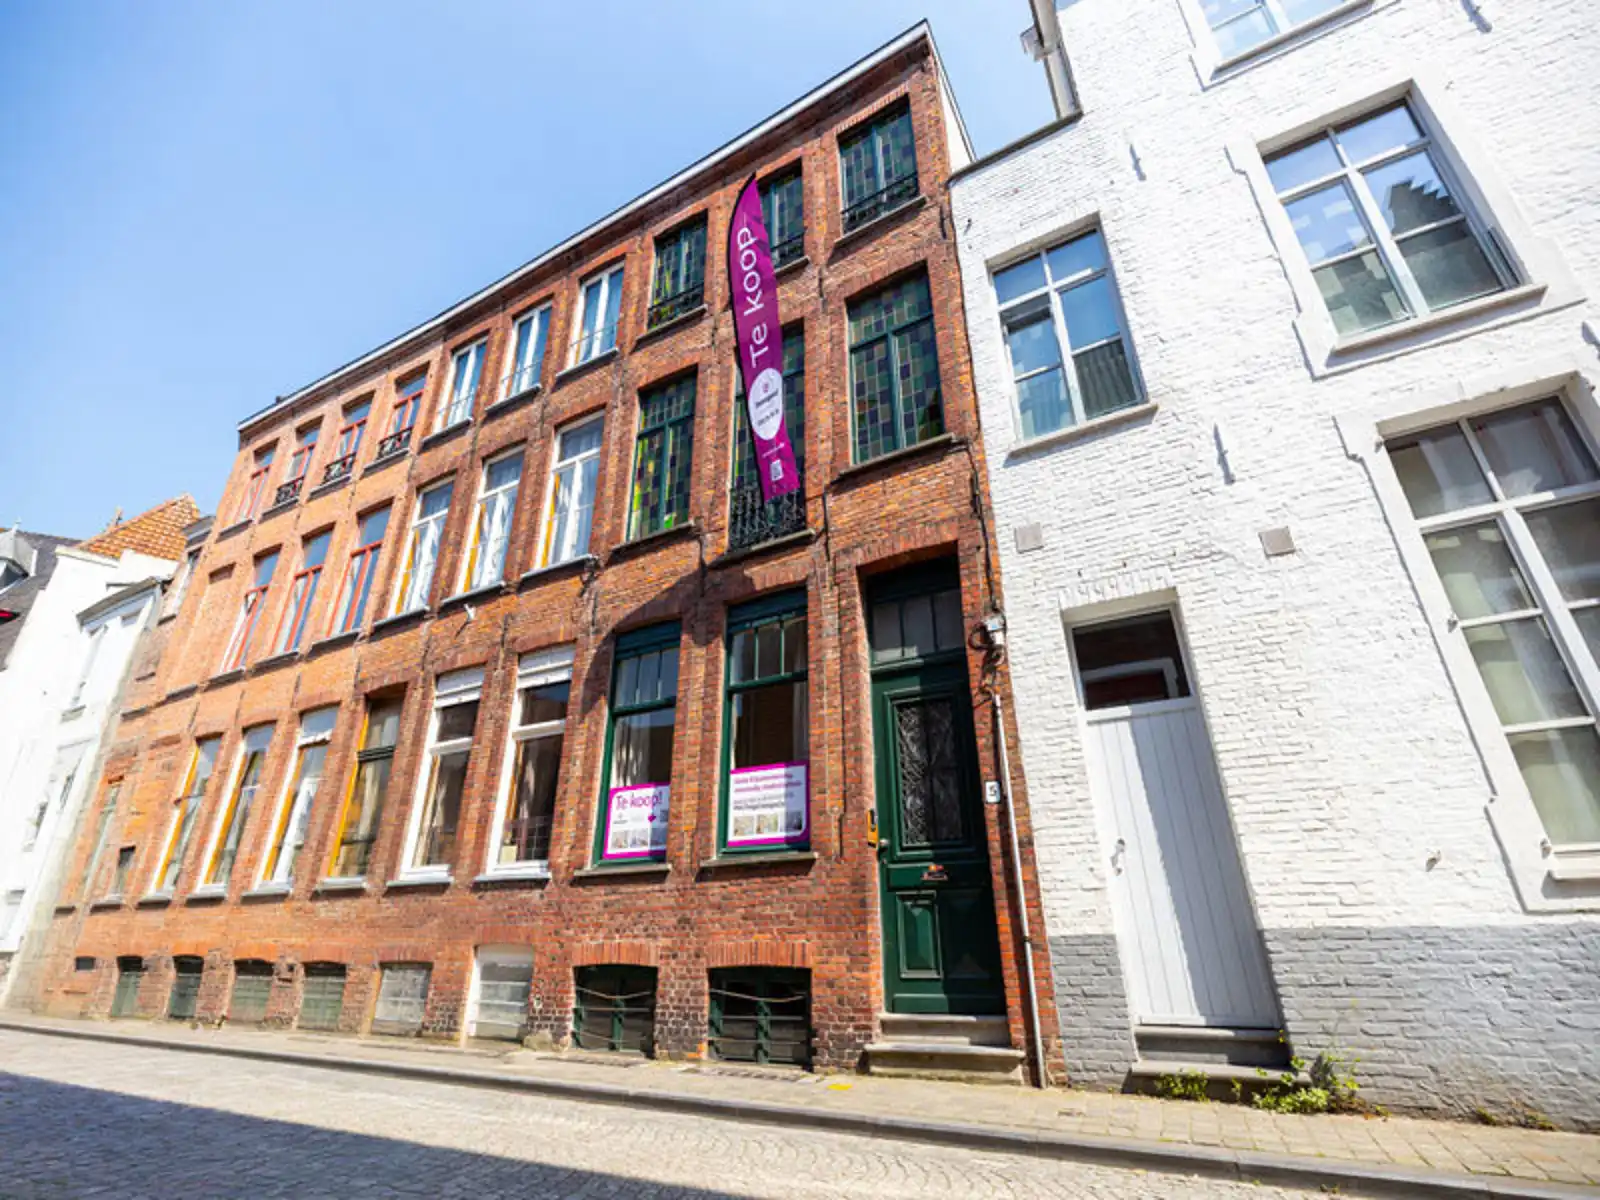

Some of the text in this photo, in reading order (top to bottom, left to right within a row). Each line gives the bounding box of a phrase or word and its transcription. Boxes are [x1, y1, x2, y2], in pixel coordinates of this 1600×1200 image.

[737, 226, 764, 316] koop
[750, 322, 769, 368] Te
[616, 795, 628, 810] Te
